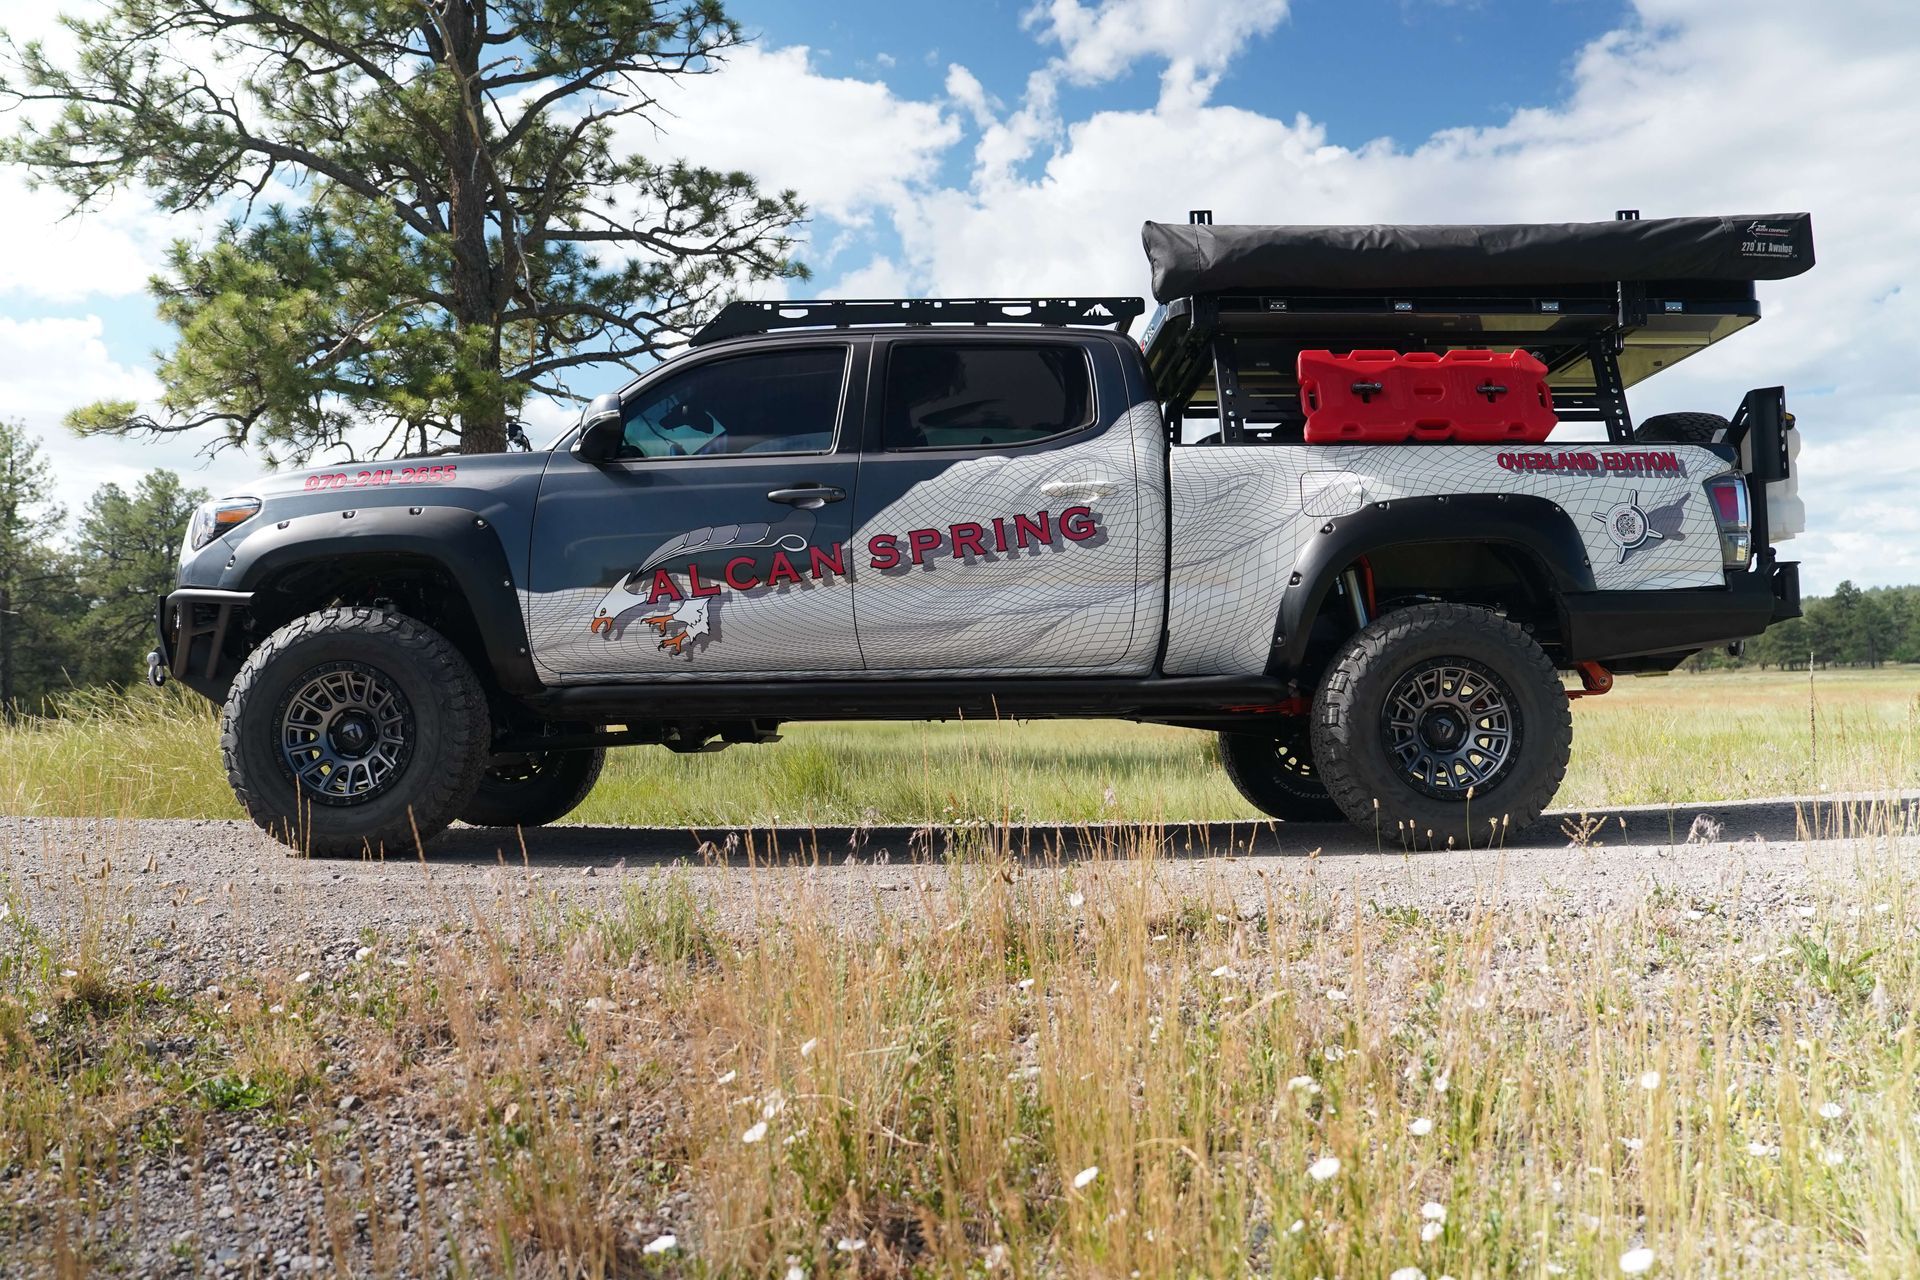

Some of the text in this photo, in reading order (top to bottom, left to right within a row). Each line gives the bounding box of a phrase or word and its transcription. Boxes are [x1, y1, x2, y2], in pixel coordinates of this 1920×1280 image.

[1497, 452, 1680, 471] OVERLAND EDITION
[304, 465, 457, 491] 970-241-2655
[647, 506, 1098, 604] ALCAN SPRING
